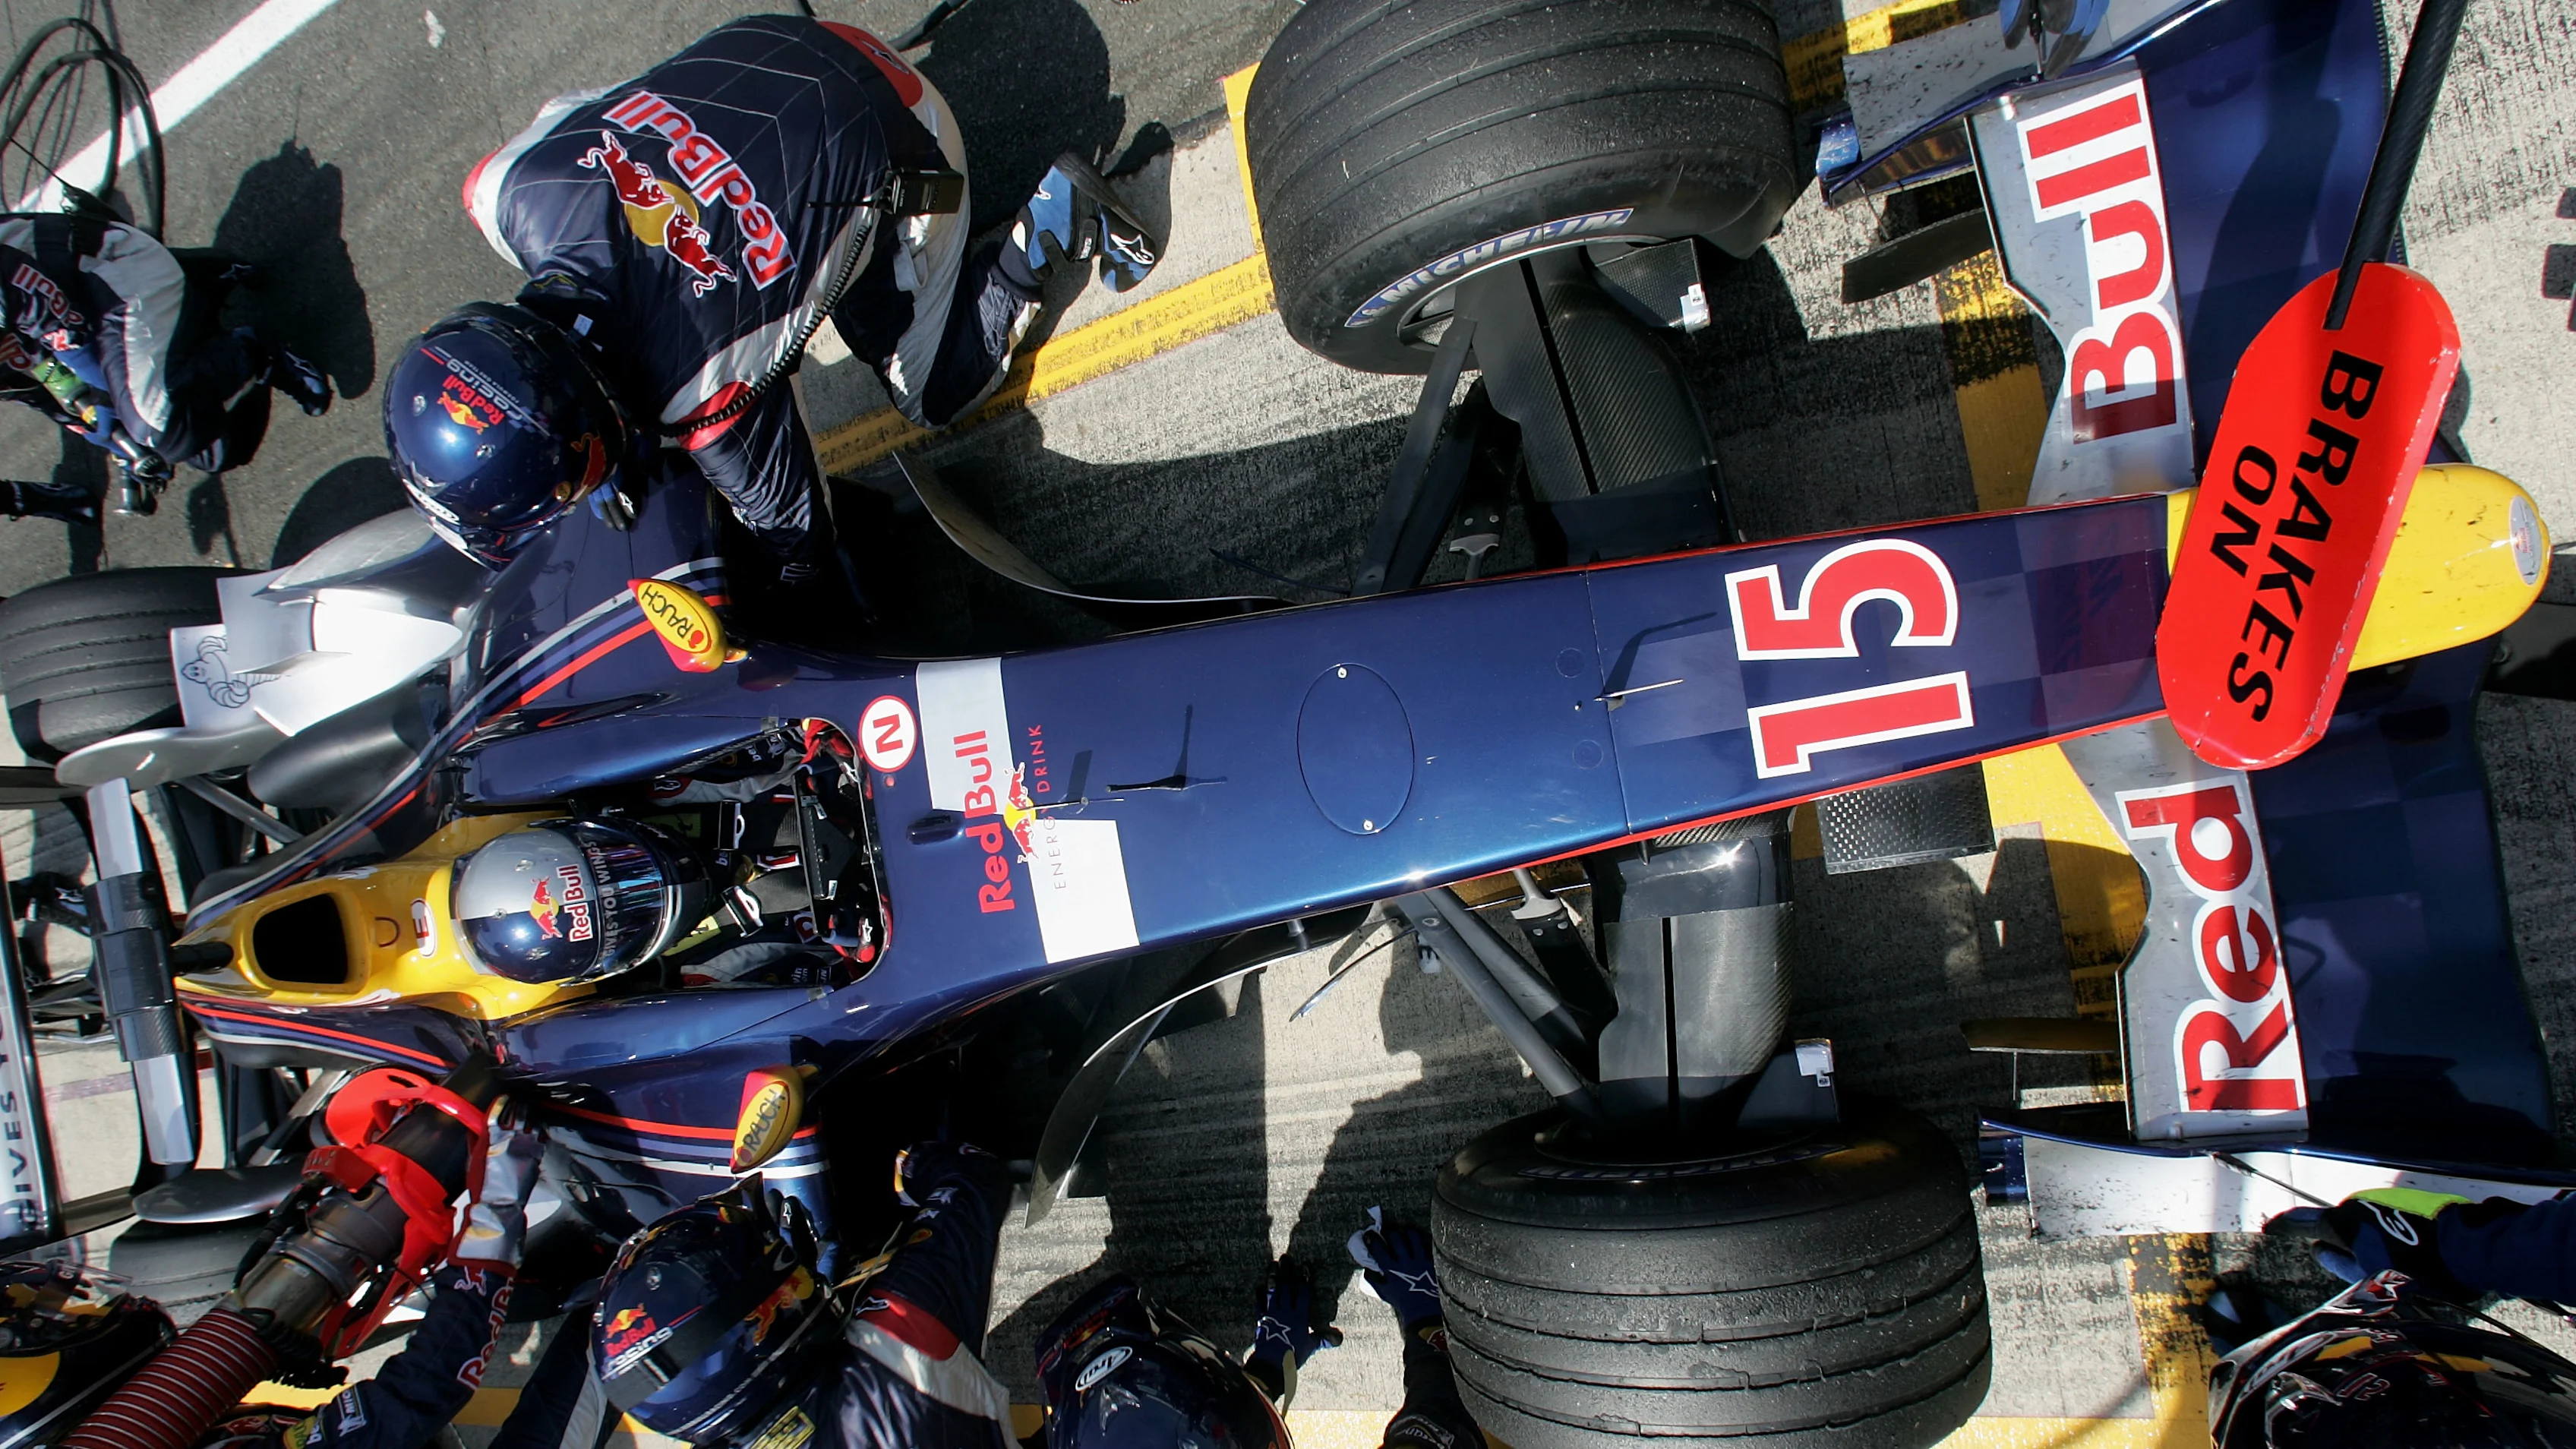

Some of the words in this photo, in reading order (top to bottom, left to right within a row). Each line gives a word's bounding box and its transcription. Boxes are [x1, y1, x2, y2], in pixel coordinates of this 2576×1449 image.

[605, 92, 731, 188] Bull
[694, 165, 797, 289] Red
[1380, 213, 1625, 302] MICHELIN
[2025, 91, 2177, 444] Bull
[443, 374, 477, 403] Bull
[447, 358, 523, 421] racing
[470, 396, 505, 425] Red
[2209, 444, 2278, 579] ON
[2226, 349, 2385, 723] BRAKES
[641, 584, 694, 639] RAUCH
[1725, 538, 1975, 779] 15
[953, 730, 997, 819] Bull
[1028, 724, 1051, 793] DRINK
[557, 863, 586, 904] Bull
[582, 841, 611, 884] WINGS
[965, 822, 1015, 914] Red
[564, 902, 593, 942] Red
[601, 886, 618, 920] YOU
[2123, 784, 2300, 1113] Red
[743, 1088, 786, 1151] RAUCH
